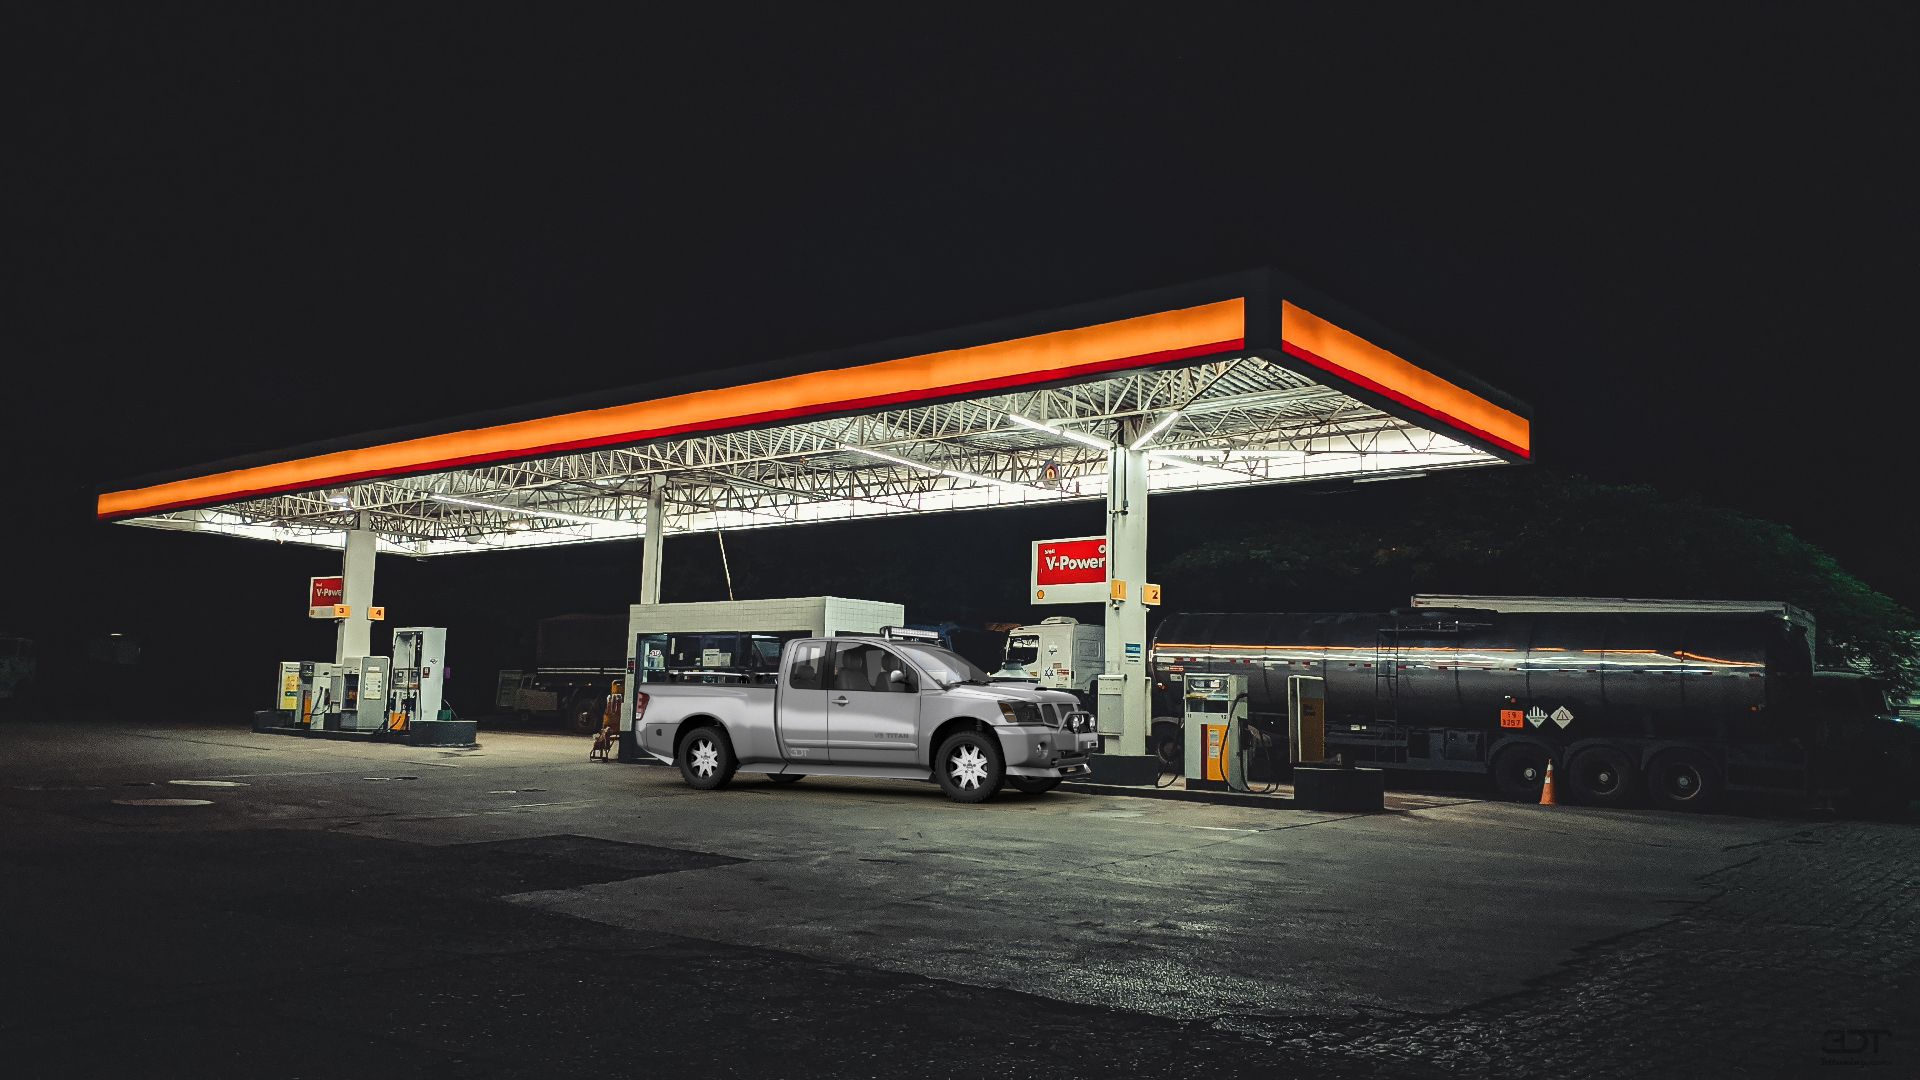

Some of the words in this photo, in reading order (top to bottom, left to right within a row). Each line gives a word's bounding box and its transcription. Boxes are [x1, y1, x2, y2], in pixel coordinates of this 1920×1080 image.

[1045, 555, 1106, 571] V-Power
[316, 588, 342, 597] V-Powe
[1152, 589, 1159, 600] 2
